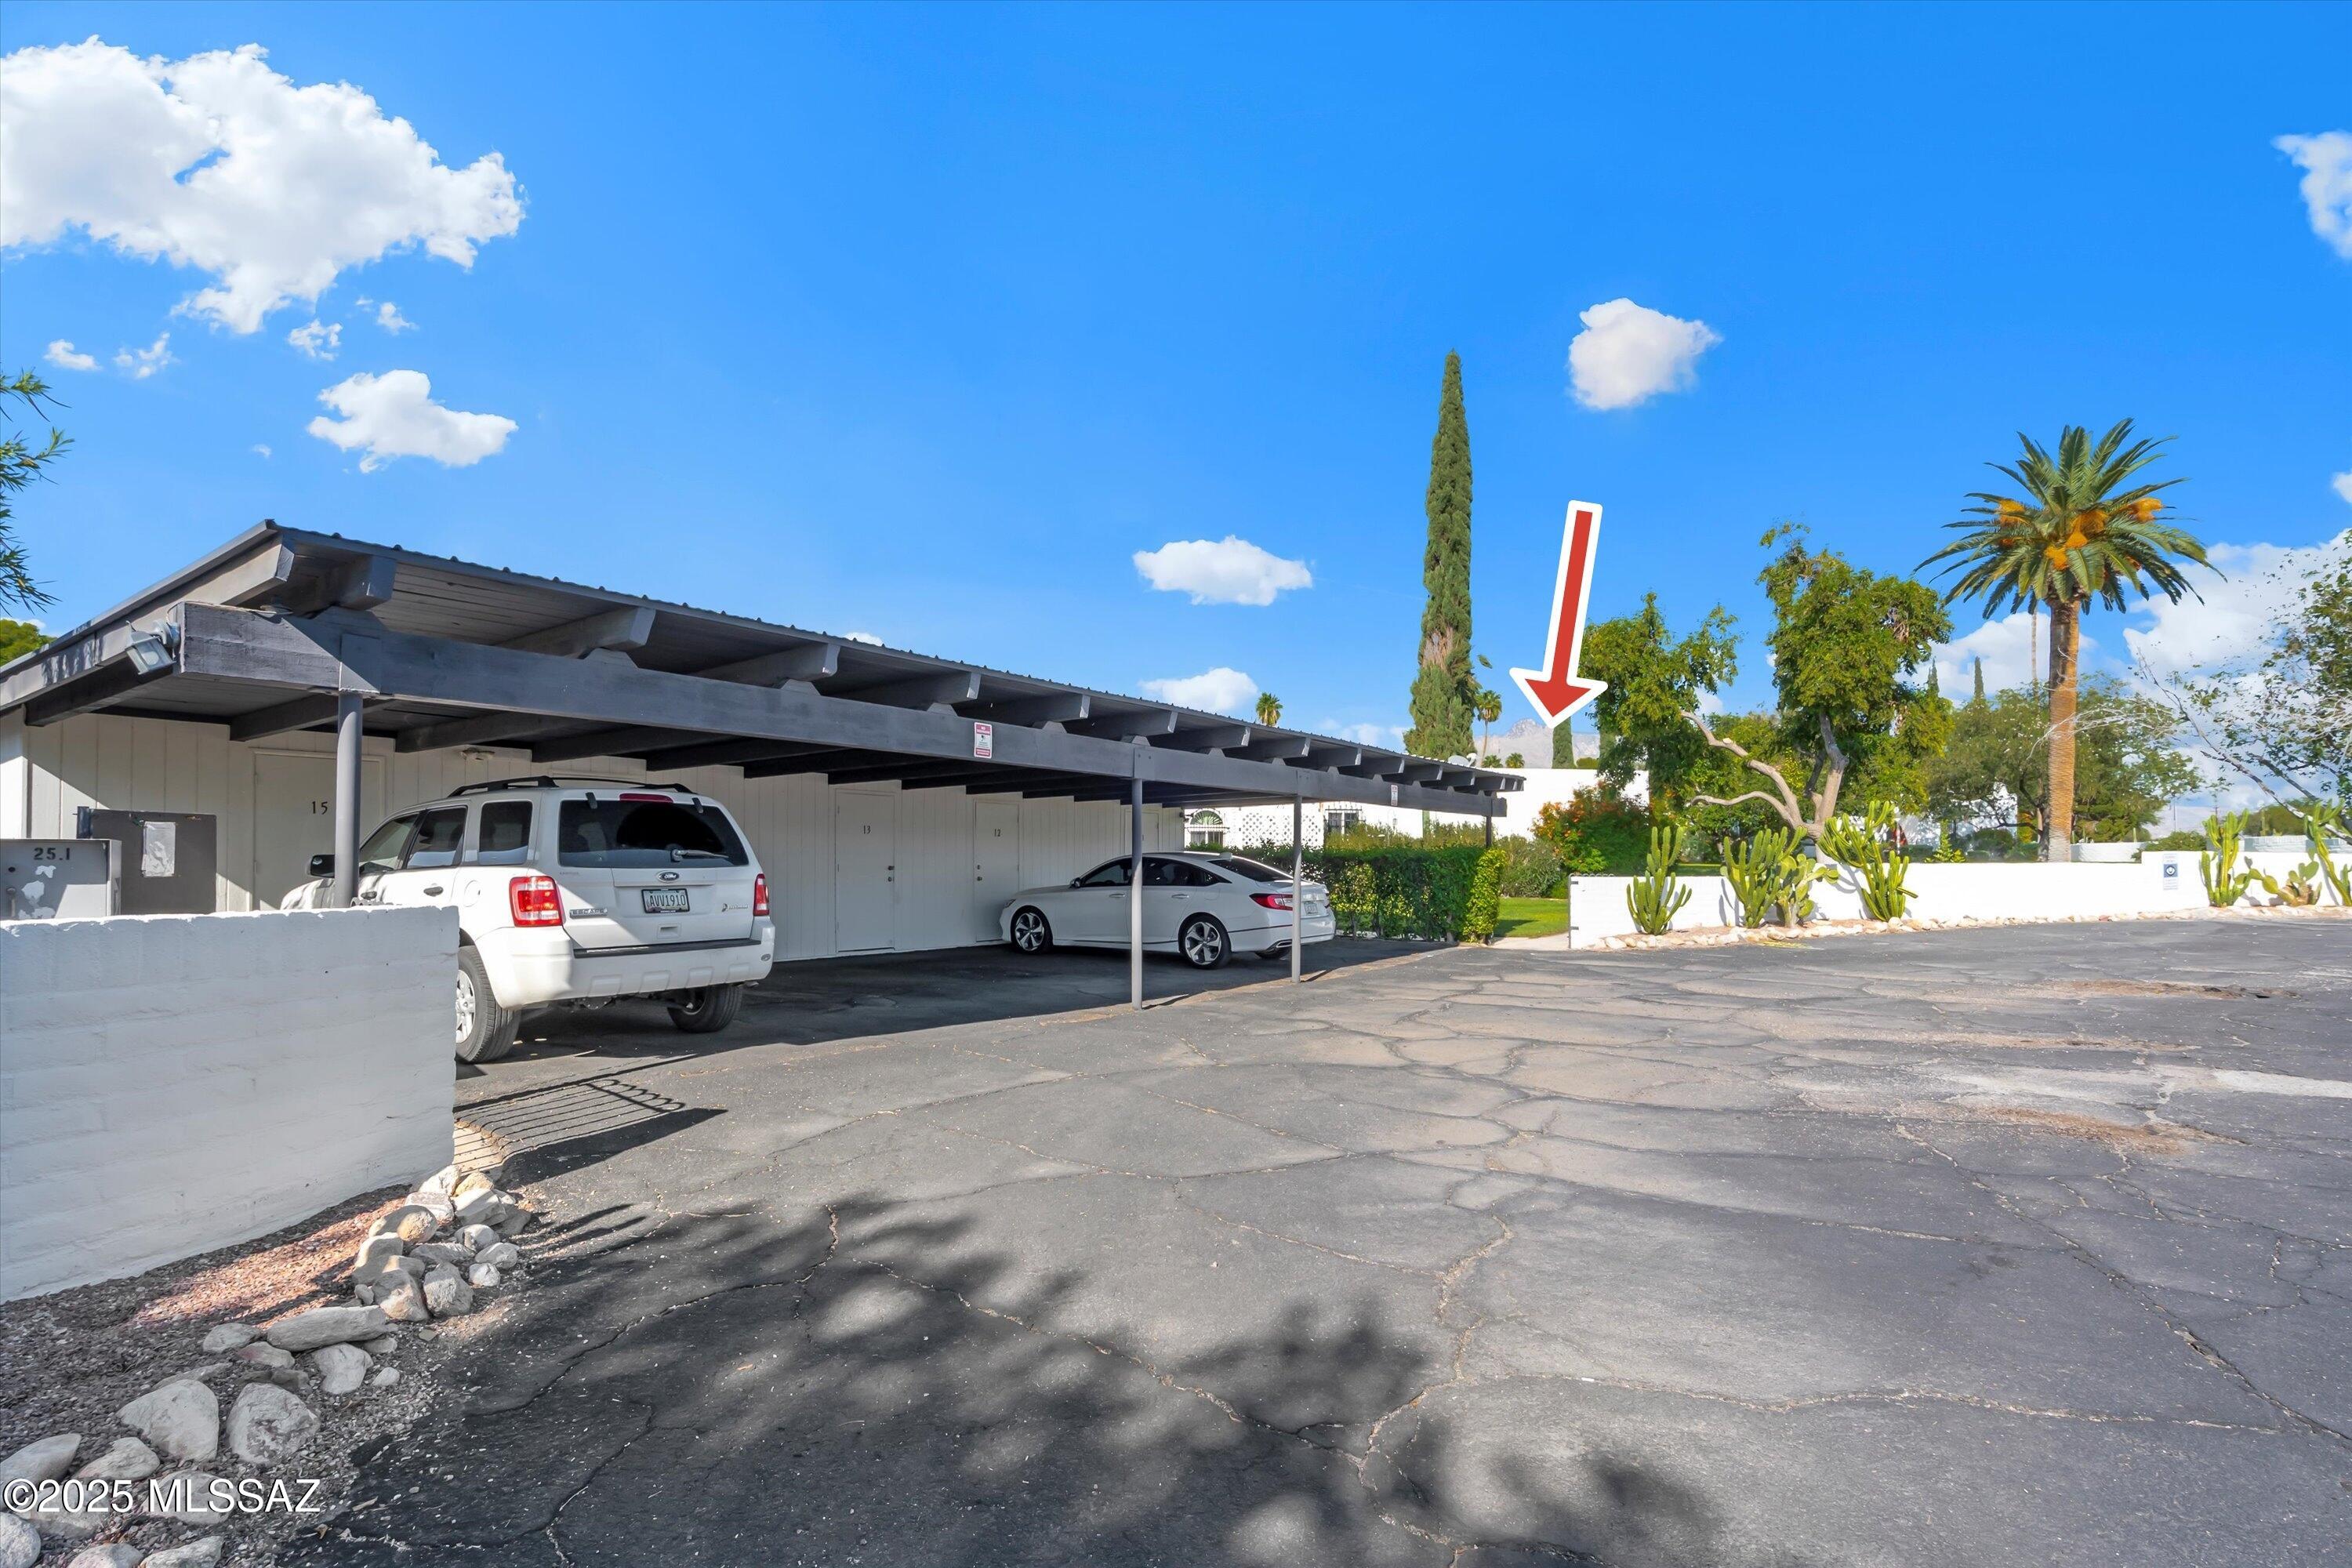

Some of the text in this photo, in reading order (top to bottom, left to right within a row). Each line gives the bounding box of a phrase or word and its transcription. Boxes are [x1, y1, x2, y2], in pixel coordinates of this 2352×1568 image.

[312, 800, 328, 815] 15
[863, 825, 871, 835] 13
[994, 828, 1001, 837] 12
[34, 847, 71, 861] 25.1
[650, 894, 687, 907] AVV1910
